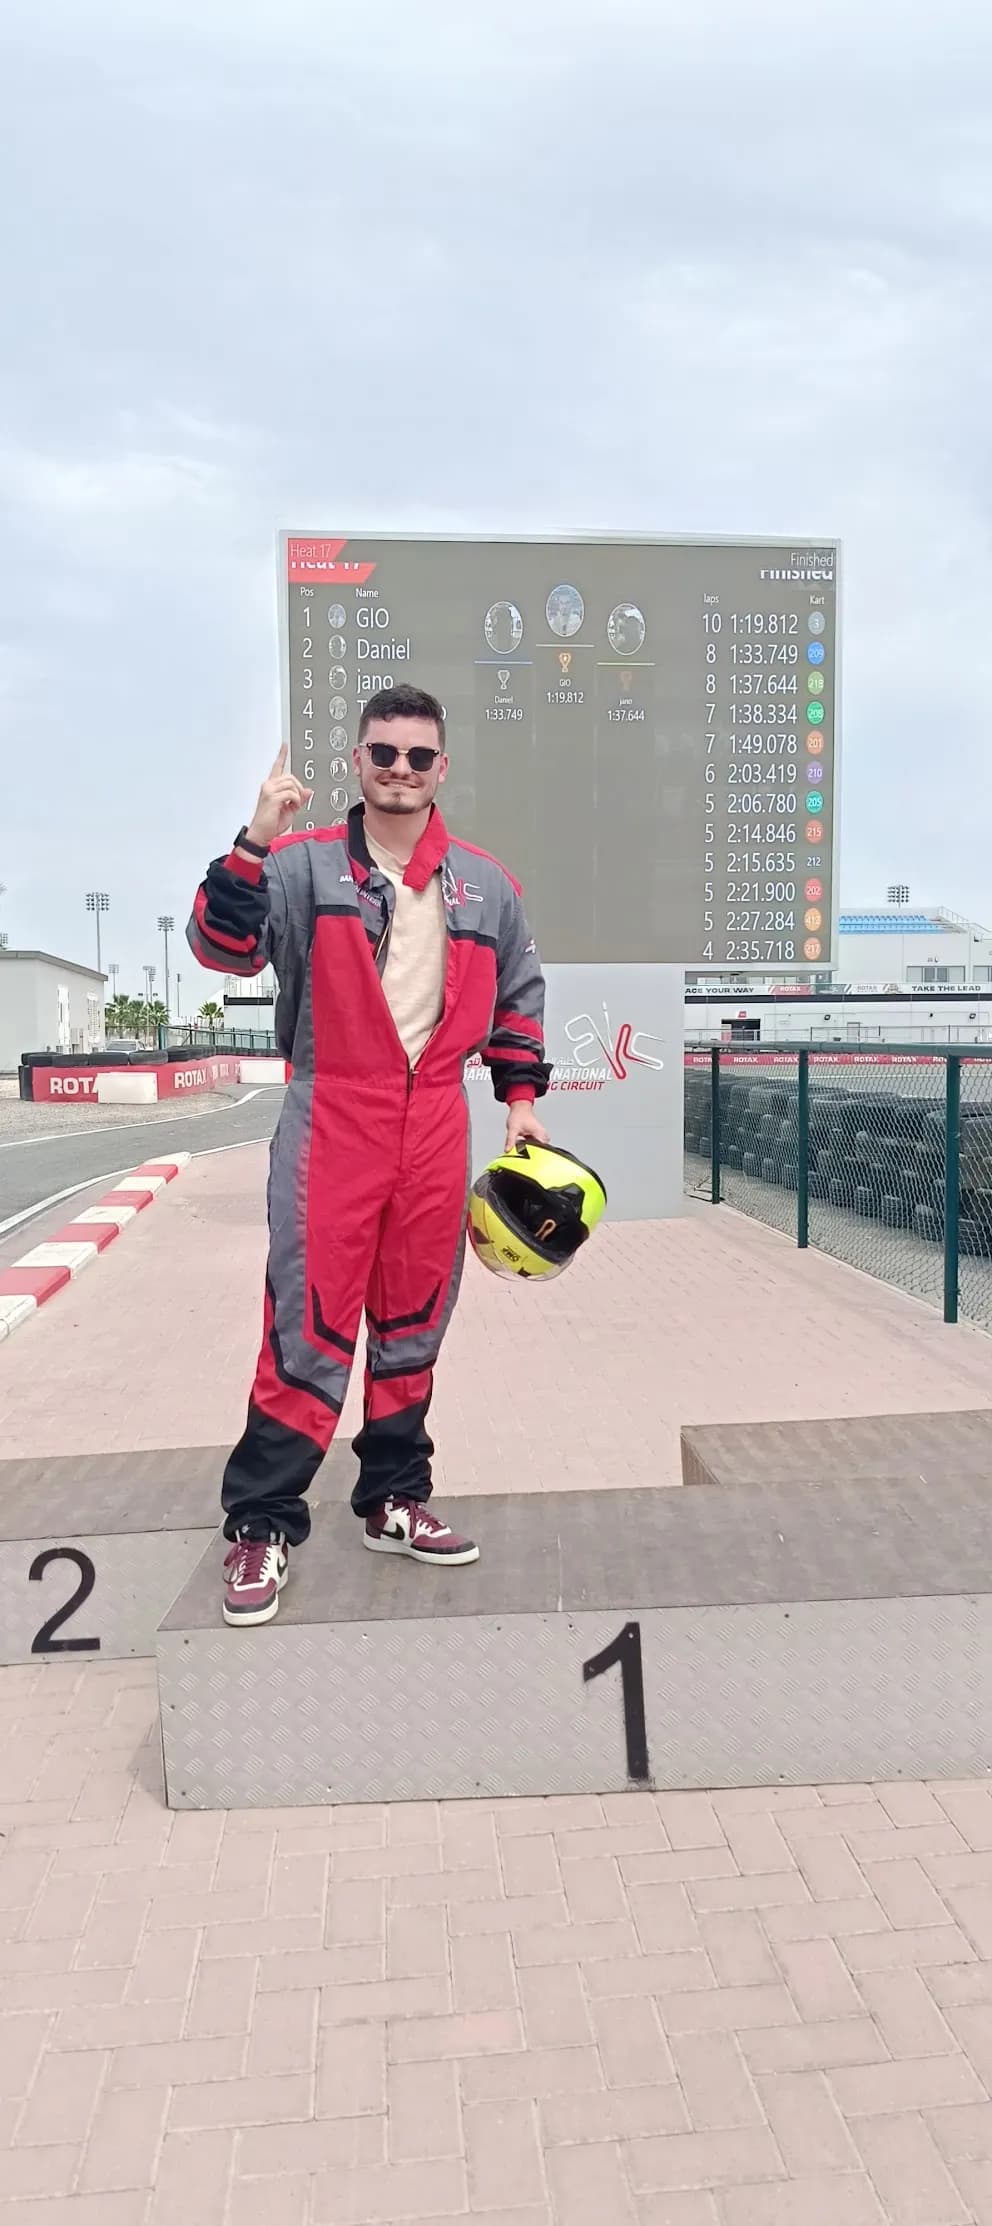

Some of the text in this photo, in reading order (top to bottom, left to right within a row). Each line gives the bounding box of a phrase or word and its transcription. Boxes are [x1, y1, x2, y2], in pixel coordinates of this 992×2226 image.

[290, 543, 331, 558] Heat 17
[791, 552, 833, 567] Finished
[300, 587, 379, 598] Pos Name
[703, 593, 825, 605] laps Kart
[303, 607, 389, 628] 1 GIO
[702, 613, 722, 633] 10
[730, 613, 798, 634] 1:19.812
[303, 638, 410, 660] 2 Daniel
[705, 643, 716, 664] 8
[730, 644, 798, 665] 1:33.749
[303, 668, 394, 694] 3 jano
[559, 678, 571, 687] GIO
[705, 674, 716, 694] 8
[729, 674, 798, 694] 1:37.644
[494, 695, 514, 704] Daniel
[546, 692, 584, 704] 1:19.812
[303, 699, 314, 719] 4
[485, 709, 523, 720] 1:33.749
[607, 710, 645, 721] 1:37.644
[705, 703, 716, 724] 7
[729, 704, 797, 724] 1:38.334
[304, 730, 314, 750] 5
[705, 734, 715, 754] 7
[729, 734, 797, 754] 1:49.078
[304, 760, 315, 780] 6
[705, 763, 823, 784] 6 2:03.419 210
[705, 794, 714, 813] 5
[727, 794, 796, 814] 2:06.780
[704, 824, 822, 843] 5 2:14.846 215
[704, 853, 821, 872] 5 2:15.635 212
[704, 882, 714, 902] 5
[727, 882, 795, 902] 2:21.900
[704, 912, 713, 931] 5
[726, 912, 795, 931] 2:27.284
[703, 941, 713, 960] 4
[726, 941, 794, 961] 2:35.718
[550, 1067, 612, 1081] NATIONAL
[560, 1081, 605, 1091] CIRCUIT
[28, 1547, 101, 1654] 2
[582, 1622, 651, 1785] 1
